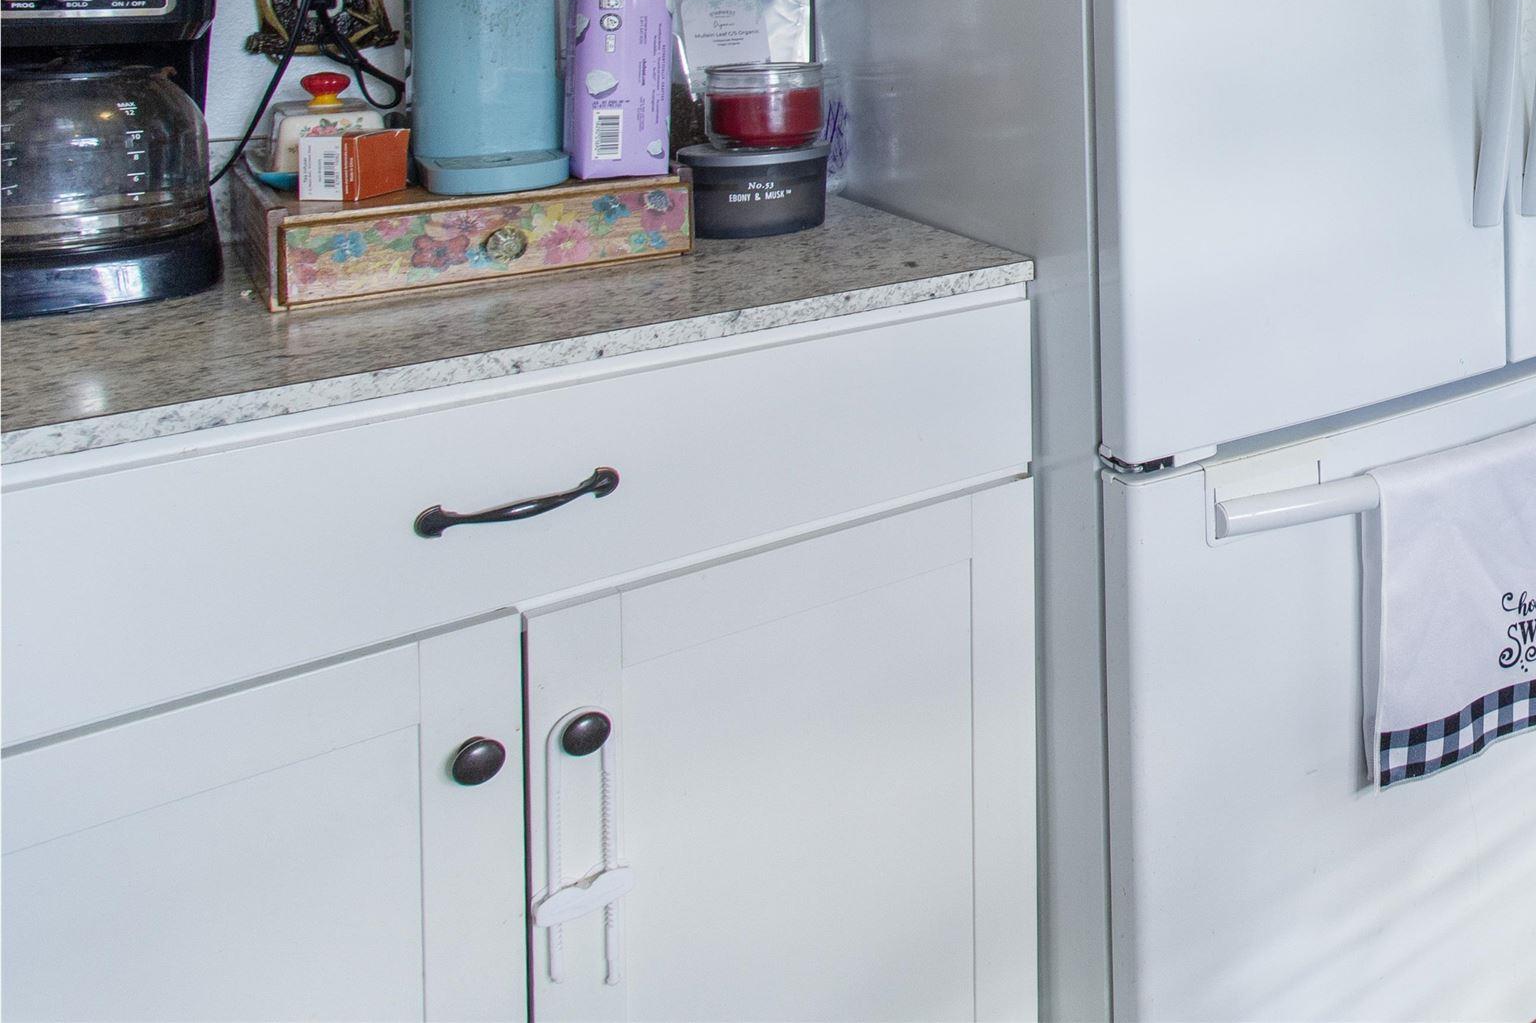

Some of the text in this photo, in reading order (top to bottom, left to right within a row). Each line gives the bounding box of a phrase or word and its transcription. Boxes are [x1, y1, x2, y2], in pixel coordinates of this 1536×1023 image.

[747, 181, 775, 190] No.53
[728, 193, 752, 203] EBONY
[754, 192, 761, 201] &
